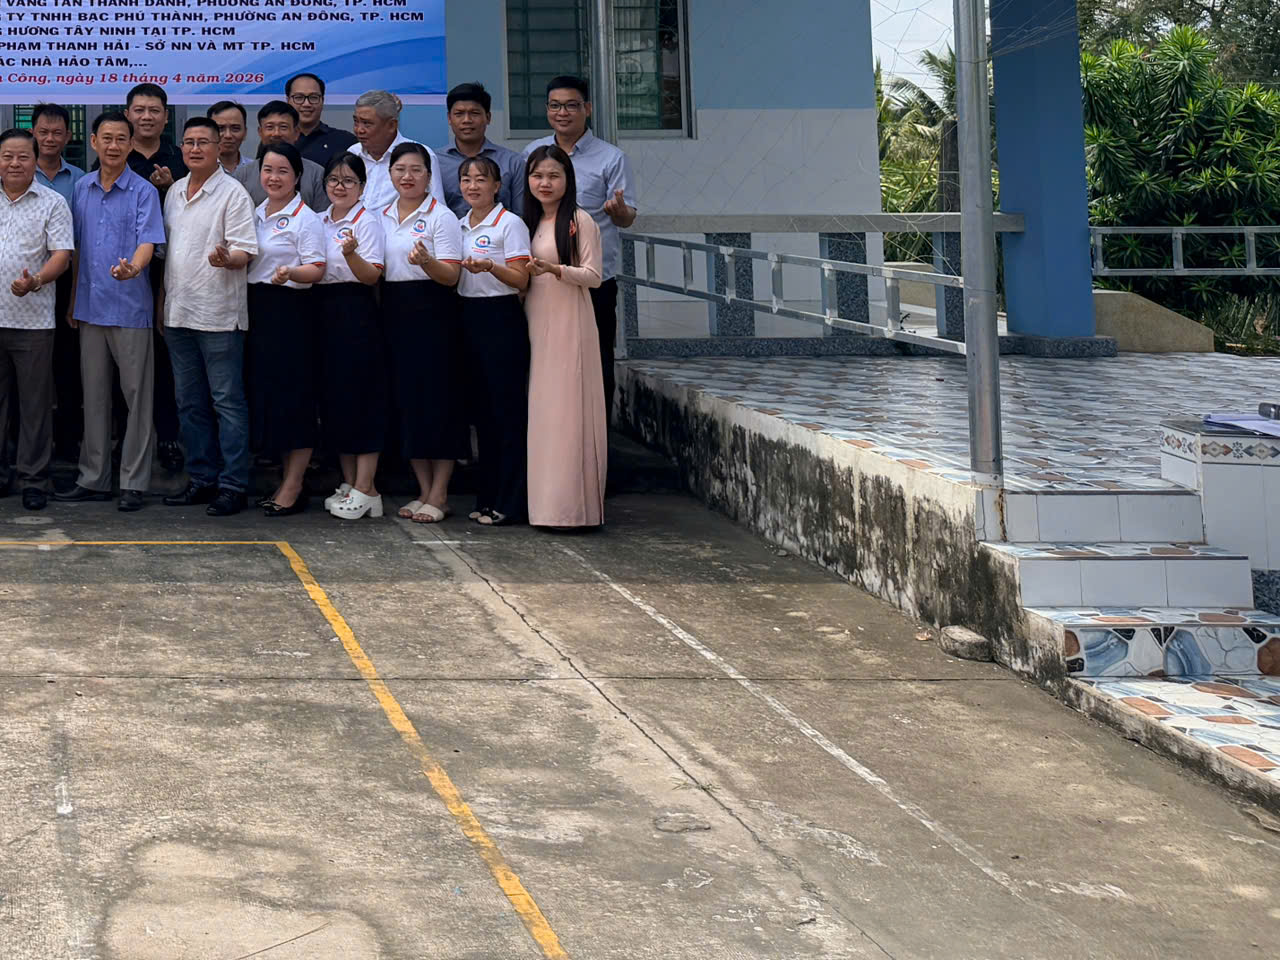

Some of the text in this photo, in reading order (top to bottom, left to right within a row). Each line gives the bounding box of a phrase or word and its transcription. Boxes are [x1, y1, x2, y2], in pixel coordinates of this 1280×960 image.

[5, 12, 26, 22] TY
[29, 11, 73, 22] TNHH
[77, 12, 110, 23] BẠC
[114, 10, 145, 22] PHÚ
[150, 10, 209, 23] THÀNH,
[213, 9, 277, 22] PHƯỜNG
[281, 11, 303, 22] AN
[306, 9, 355, 23] ĐÔNG,
[359, 11, 385, 21] TP.
[389, 12, 424, 21] HCM
[7, 25, 60, 36] HƯƠNG
[63, 24, 95, 36] TÂY
[99, 26, 136, 36] NINH
[140, 26, 167, 37] TẠI
[171, 26, 196, 36] TP.
[201, 26, 236, 36] HCM
[45, 41, 98, 51] THANH
[103, 38, 130, 51] HẢI
[144, 38, 167, 51] SỞ
[170, 41, 192, 51] NN
[196, 39, 217, 51] VÀ
[222, 41, 246, 51] MT
[249, 41, 275, 51] TP.
[280, 41, 315, 51] HCM
[20, 55, 53, 67] NHÀ
[58, 54, 91, 67] HẢO
[7, 72, 51, 86] Công,
[56, 72, 95, 86] ngày
[99, 72, 119, 84] 18
[122, 72, 169, 85] tháng
[171, 72, 182, 84] 4
[186, 73, 220, 83] năm
[224, 72, 265, 84] 2026
